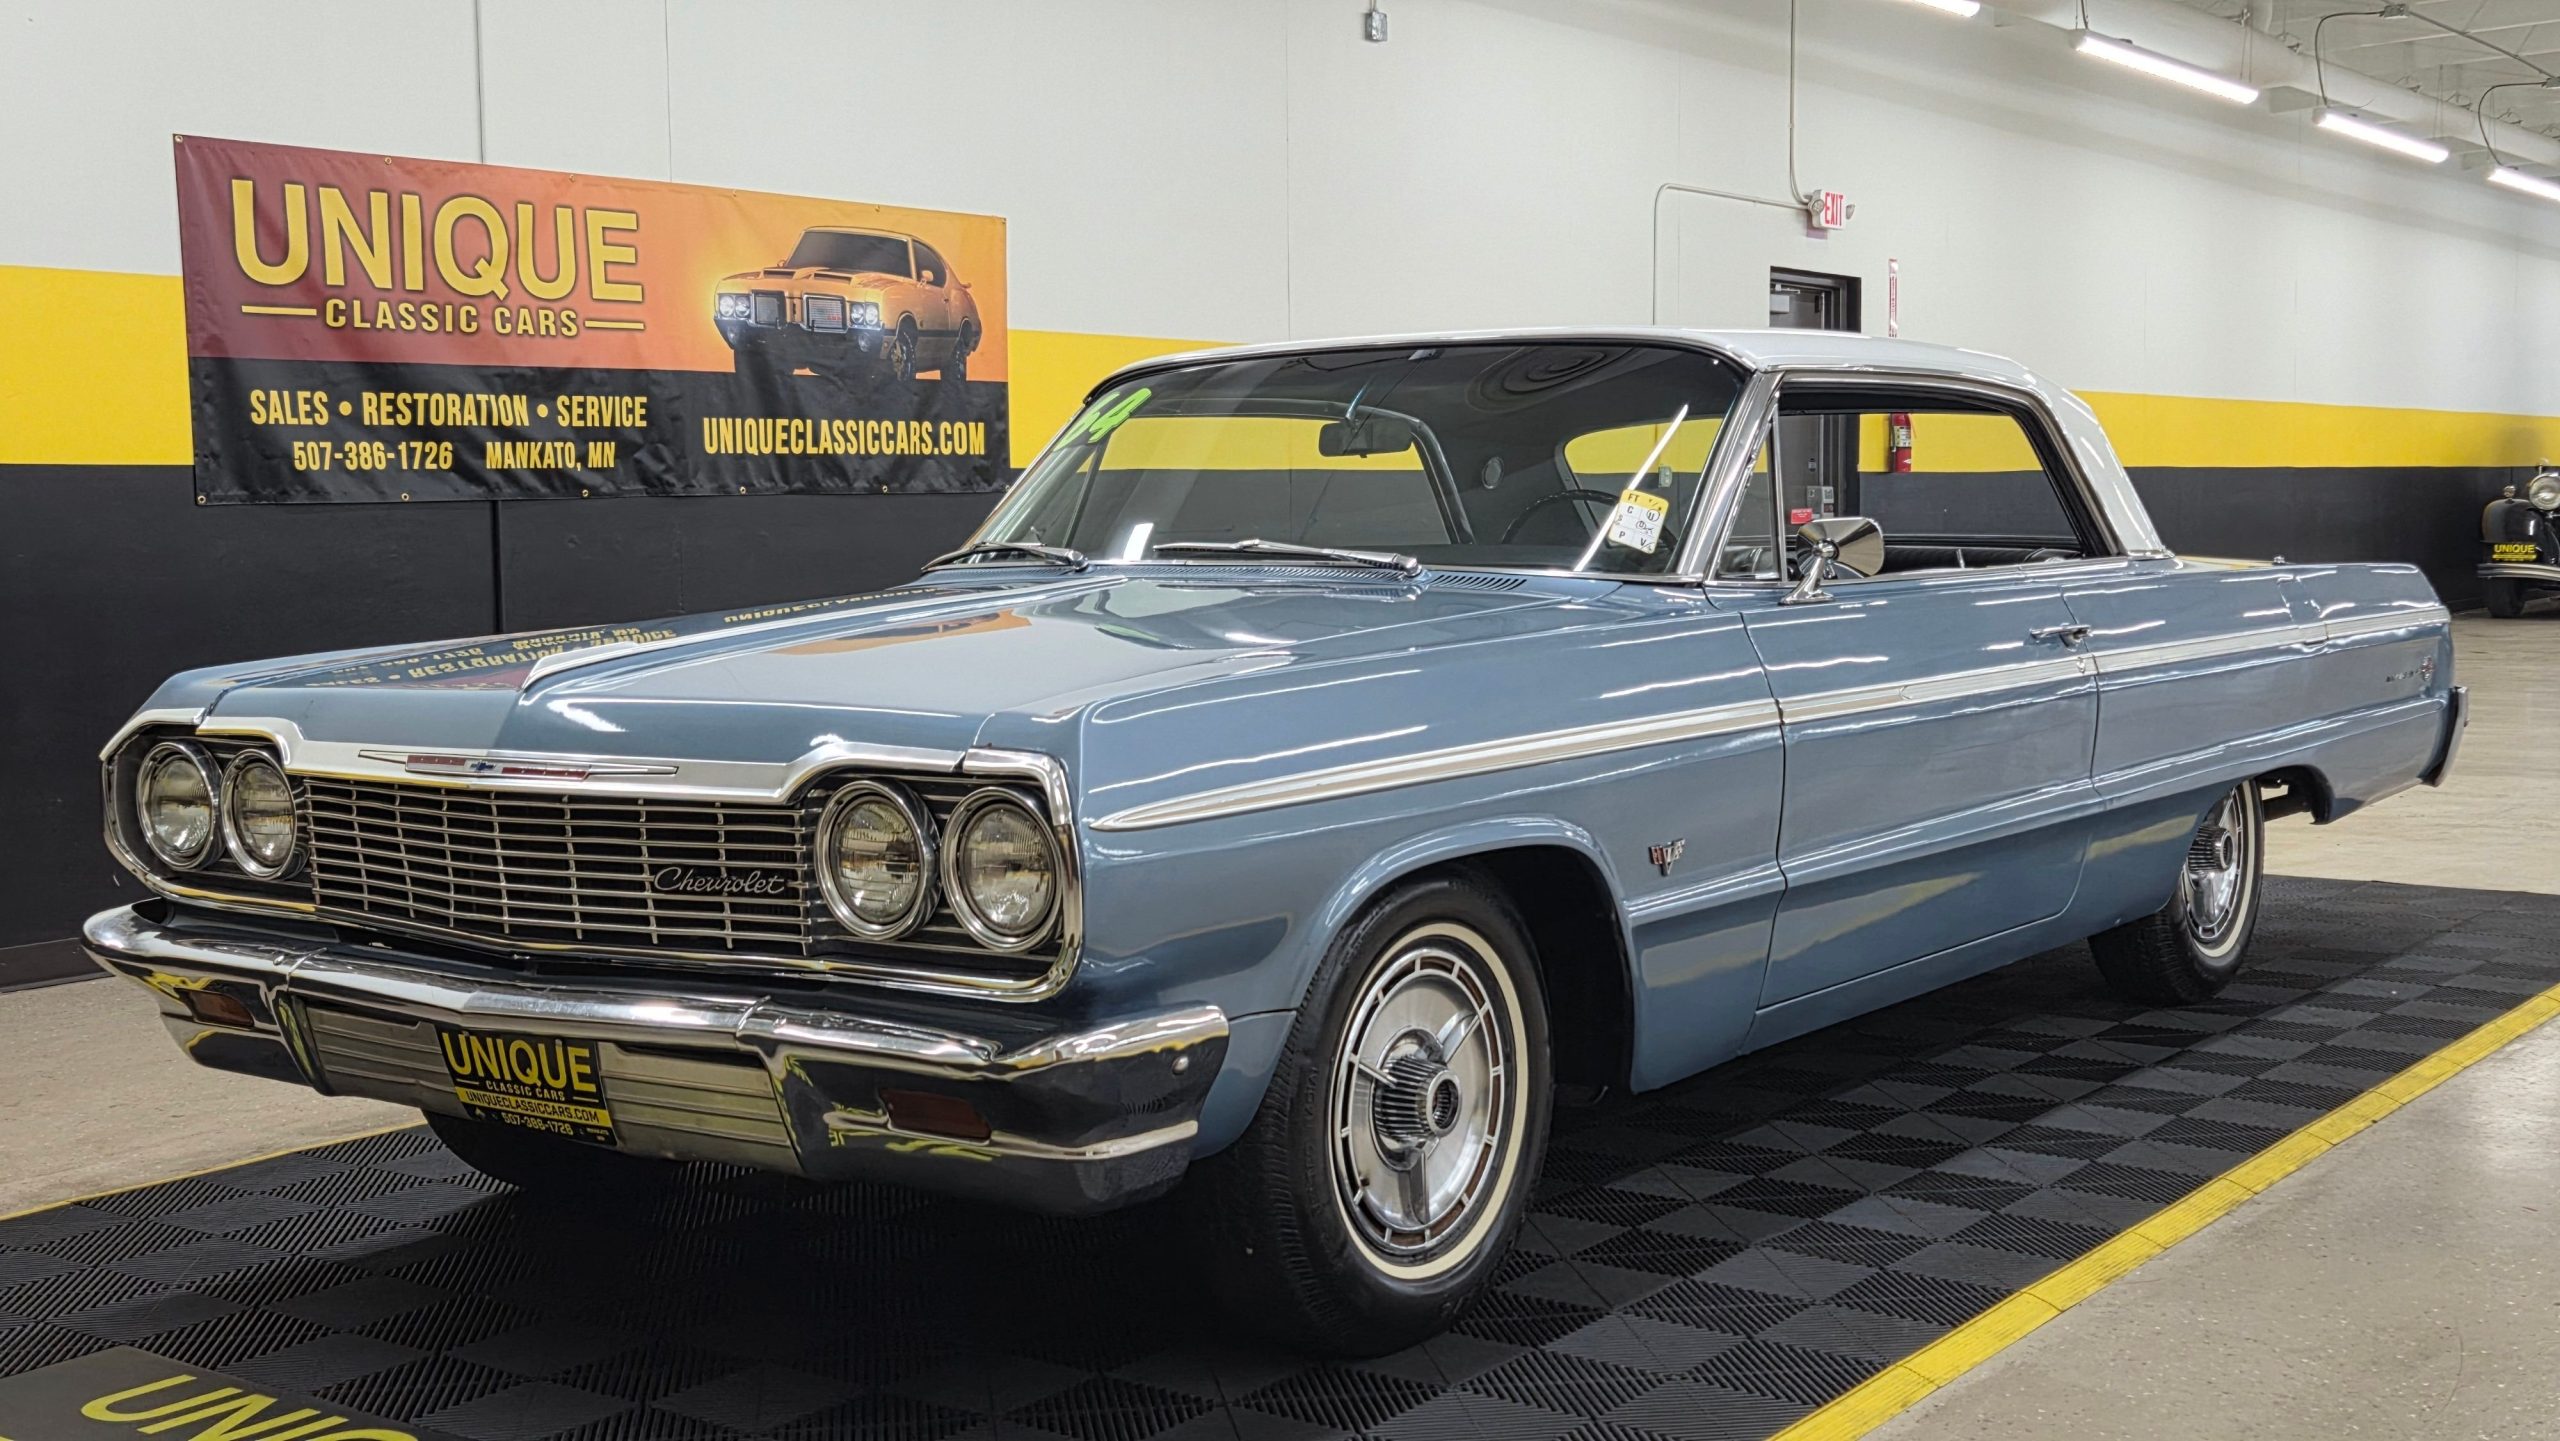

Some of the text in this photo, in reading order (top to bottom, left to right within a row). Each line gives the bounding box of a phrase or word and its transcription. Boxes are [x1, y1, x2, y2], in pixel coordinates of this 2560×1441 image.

[1824, 191, 1844, 227] EXIT
[231, 179, 644, 302] UNIQUE
[325, 299, 580, 337] CLASSIC CARS
[250, 390, 648, 428] SALES RESTORATION SERVICE
[703, 417, 985, 456] UNIQUECLASSICCARS.COM
[293, 441, 616, 472] 507-386-1726 MANKATO, MN
[2494, 544, 2535, 553] UNIQUE
[653, 866, 786, 894] Chevrolet
[442, 1032, 597, 1093] UNIQUE
[465, 1090, 600, 1124] UNIQUECLASSICCARS.COM
[486, 1080, 566, 1101] CLASSIC CARS
